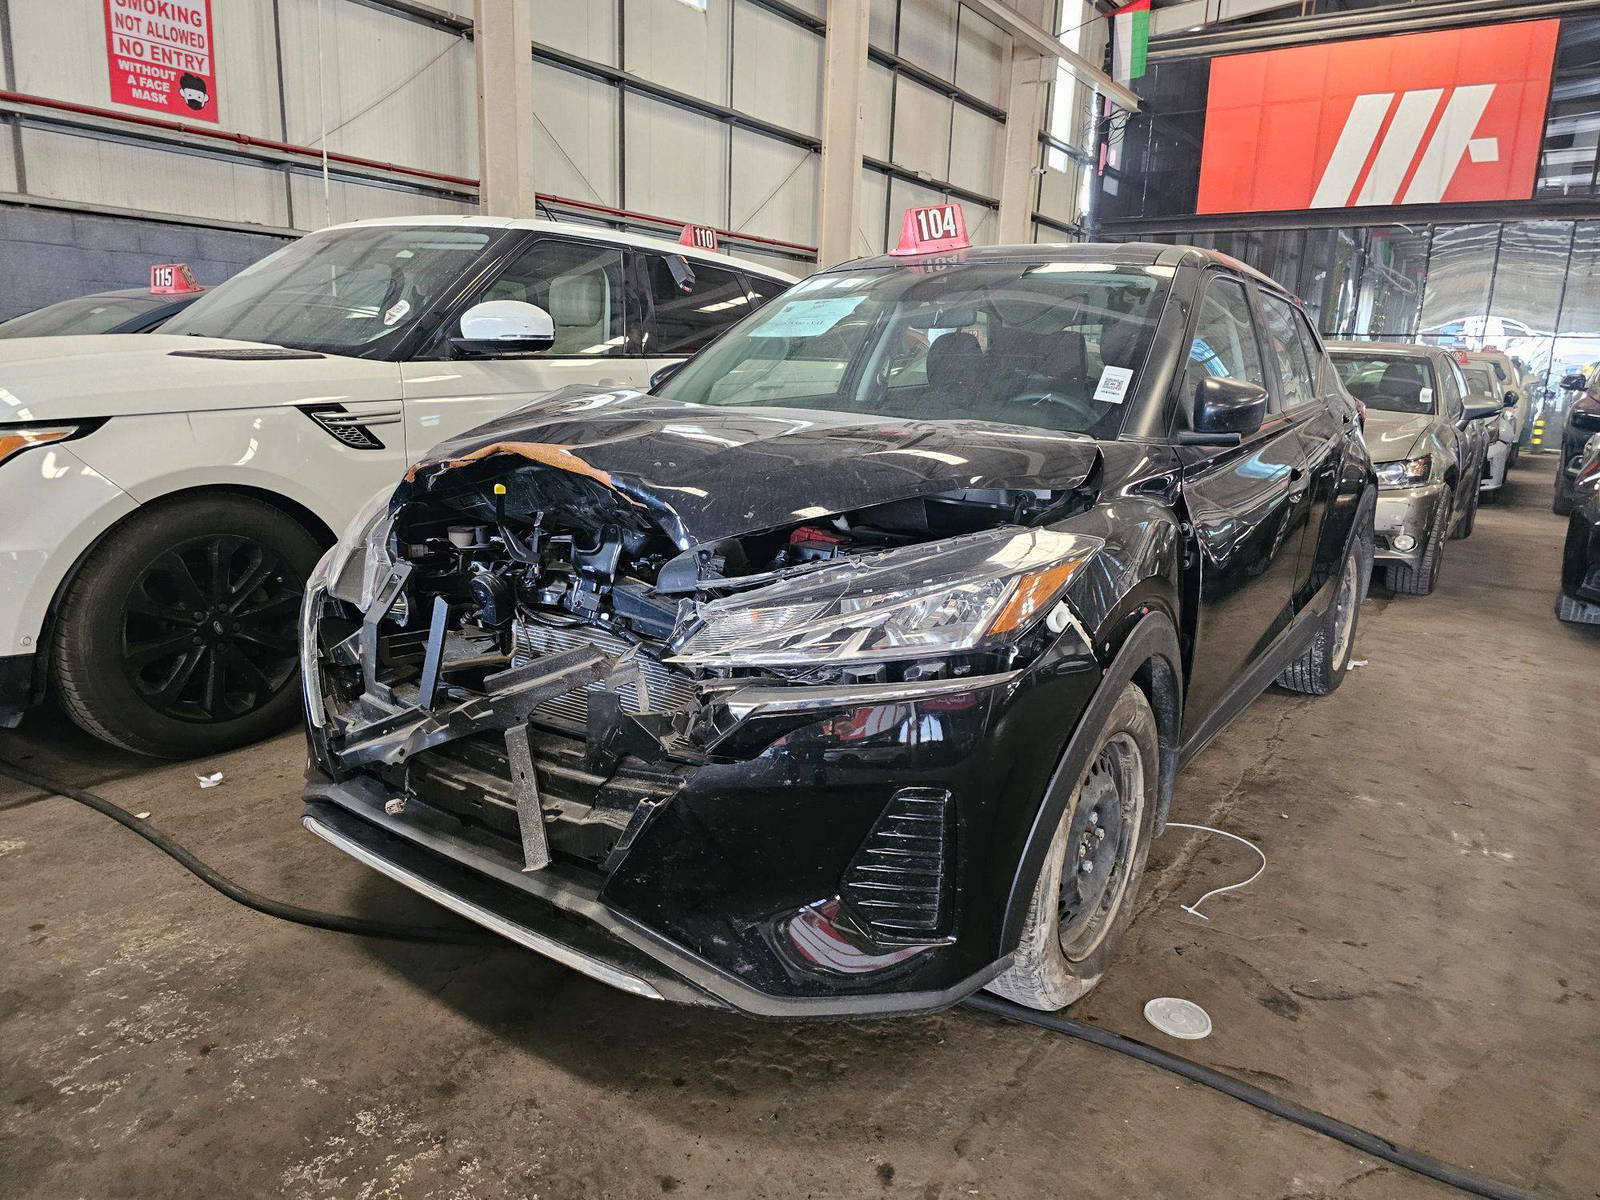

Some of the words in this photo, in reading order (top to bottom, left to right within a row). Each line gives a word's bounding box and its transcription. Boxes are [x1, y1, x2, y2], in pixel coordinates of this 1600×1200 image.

[115, 12, 142, 33] NOT
[147, 20, 205, 49] ALLOWED
[119, 37, 144, 57] NO
[150, 45, 205, 72] ENTRY
[118, 59, 176, 81] WITHOUT
[127, 74, 136, 85] A
[140, 77, 171, 92] FACE
[132, 88, 168, 105] MASK
[917, 207, 957, 241] 104
[694, 227, 714, 248] 110
[155, 268, 172, 287] 115
